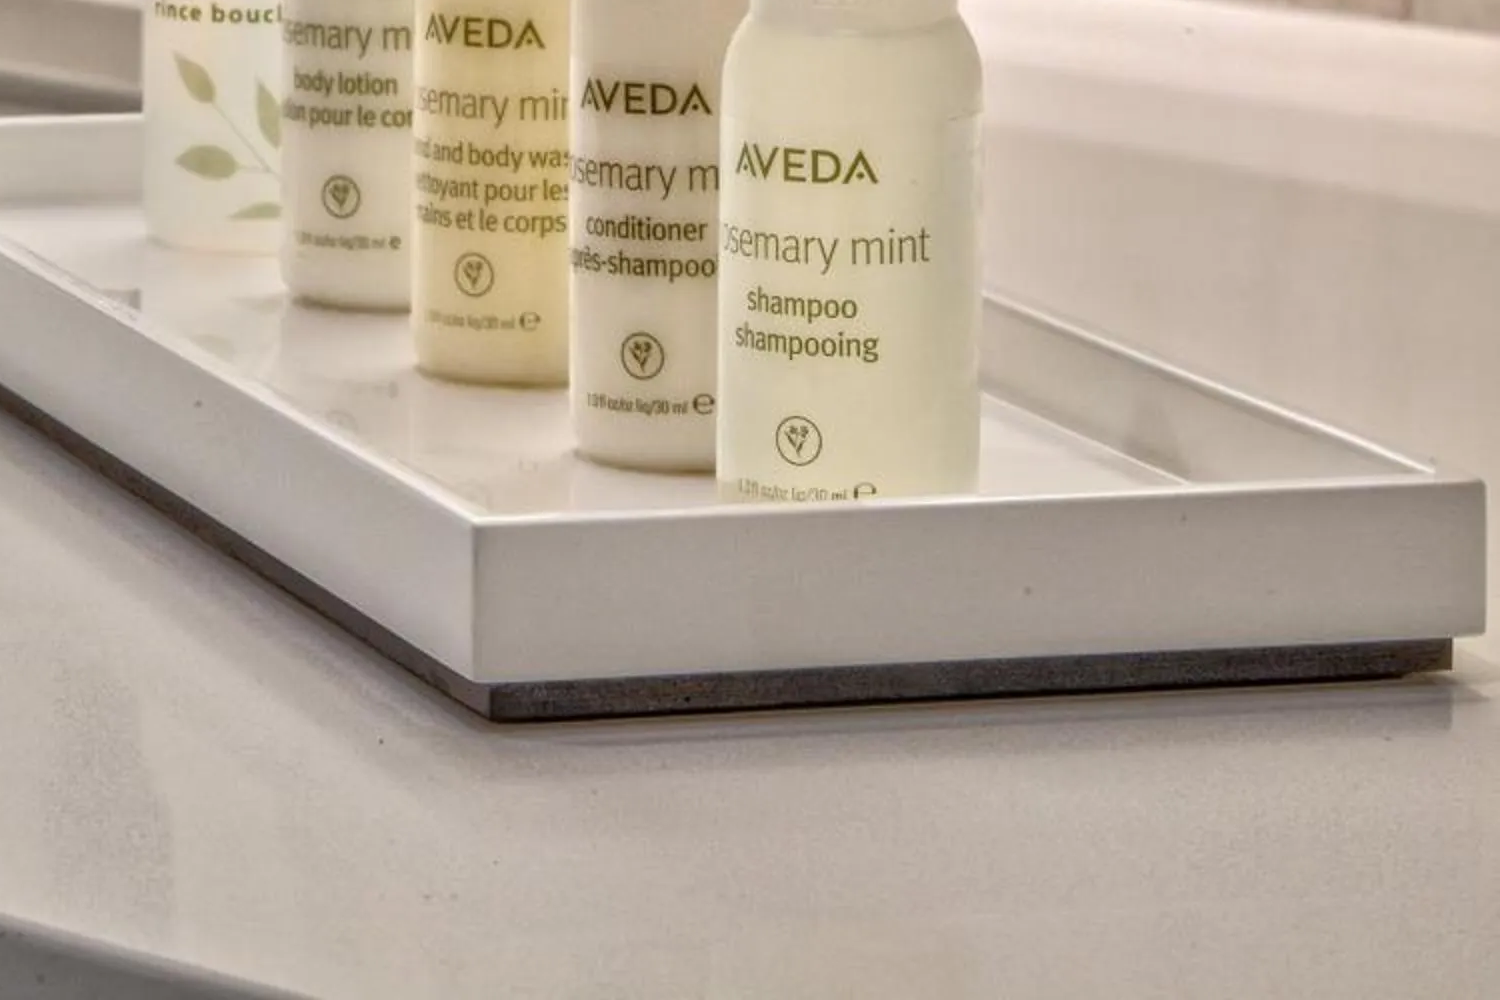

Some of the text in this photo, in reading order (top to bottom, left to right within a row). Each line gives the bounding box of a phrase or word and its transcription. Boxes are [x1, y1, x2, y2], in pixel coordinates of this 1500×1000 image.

[211, 1, 282, 23] bouc
[283, 20, 374, 61] semary
[425, 13, 546, 50] AVEDA
[293, 66, 398, 98] body lotion
[580, 77, 713, 116] AVEDA
[308, 106, 353, 130] pour
[357, 103, 376, 129] le
[380, 108, 413, 129] cor
[417, 87, 510, 130] semary
[432, 140, 463, 165] and
[467, 141, 524, 174] body
[736, 141, 879, 185] AVEDA
[484, 181, 539, 207] pour
[573, 157, 677, 201] semary
[455, 208, 475, 232] et
[479, 207, 499, 233] le
[503, 213, 568, 240] corps
[586, 214, 709, 242] conditioner
[724, 222, 931, 276] semary mint
[747, 285, 858, 325] shampoo
[735, 321, 880, 363] shampooing
